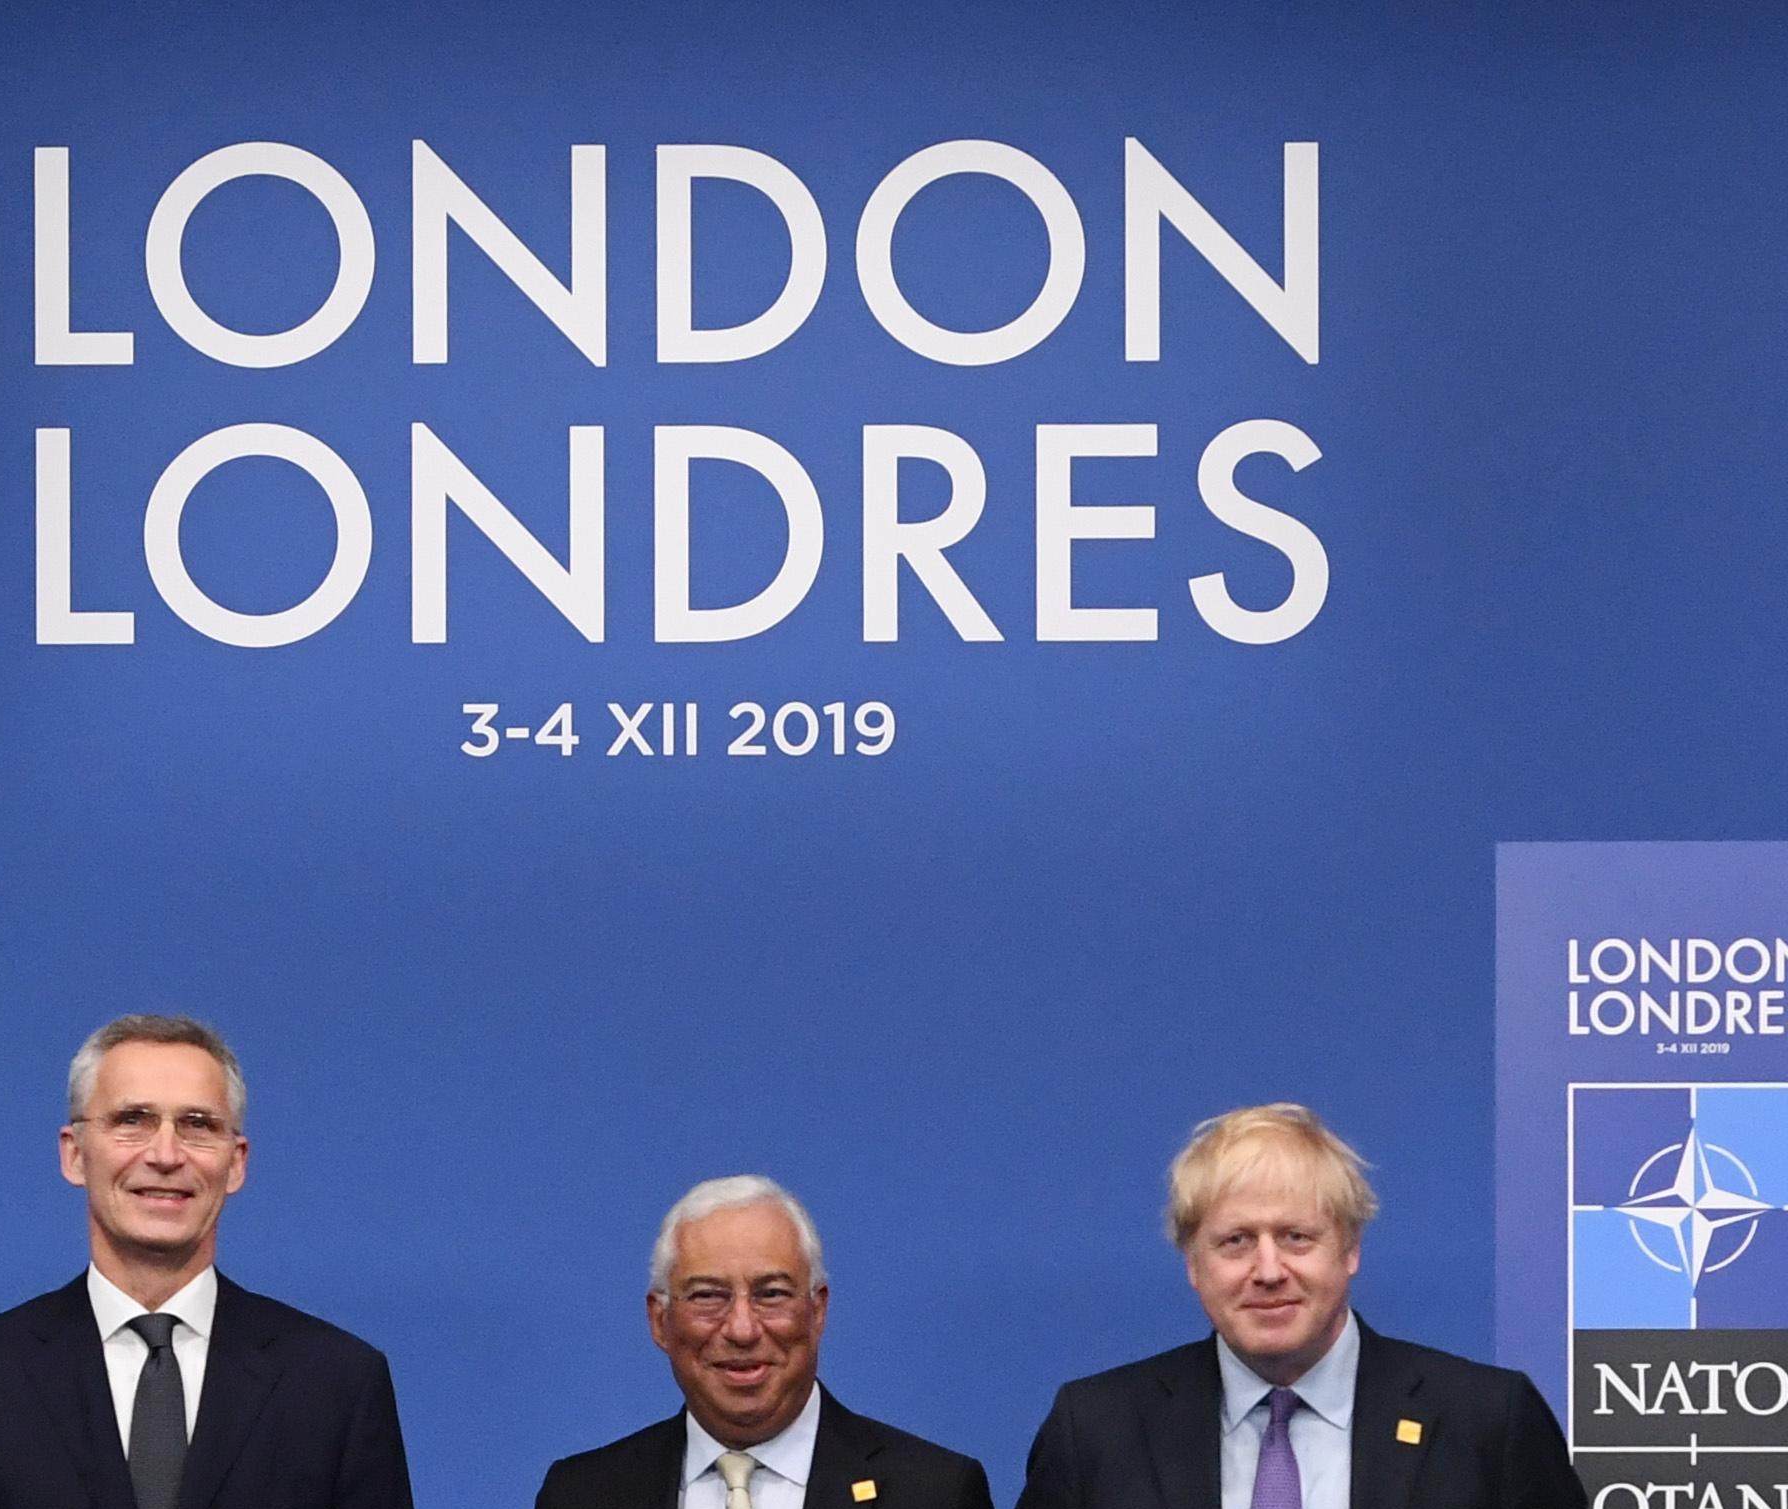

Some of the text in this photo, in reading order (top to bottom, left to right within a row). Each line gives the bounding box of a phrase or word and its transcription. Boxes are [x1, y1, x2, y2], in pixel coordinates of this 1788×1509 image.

[35, 138, 1319, 368] LONDON
[36, 420, 1328, 647] LONDRES
[461, 702, 895, 756] 3-4 XII 2019
[1657, 1043, 1730, 1054] 3-4 XII 2019
